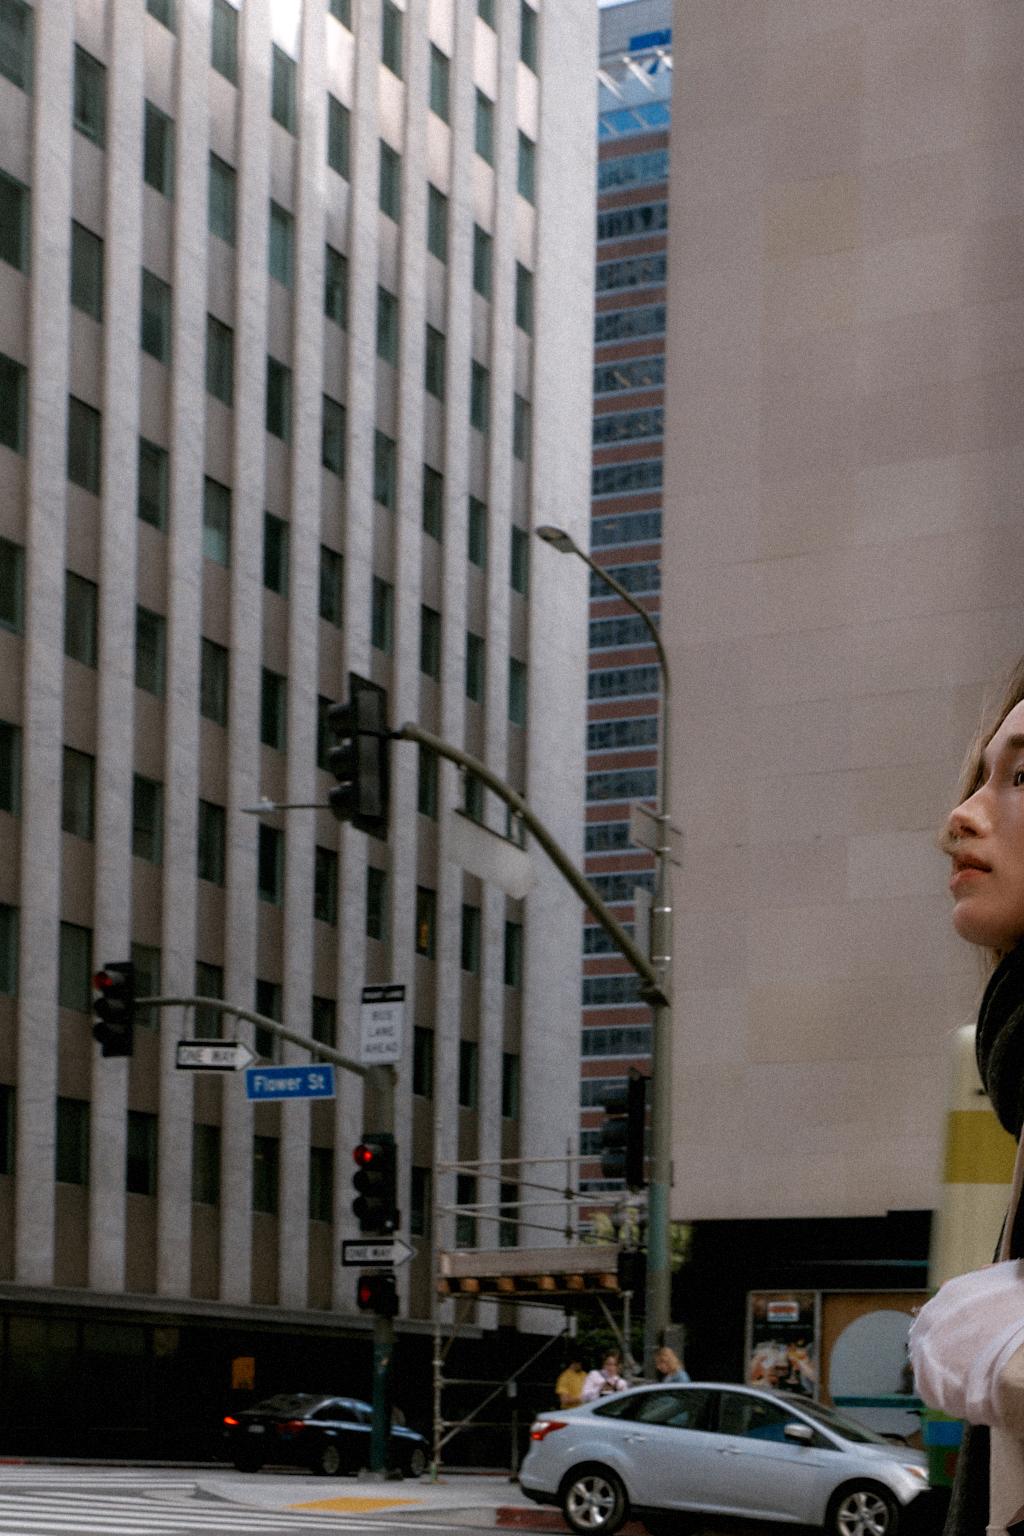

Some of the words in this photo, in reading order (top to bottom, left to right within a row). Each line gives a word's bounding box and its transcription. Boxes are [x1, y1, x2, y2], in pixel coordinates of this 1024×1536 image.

[179, 1048, 203, 1063] ONE
[210, 1049, 236, 1063] WAY
[253, 1075, 302, 1092] Flower
[307, 1073, 325, 1090] St
[371, 1247, 392, 1259] WAY
